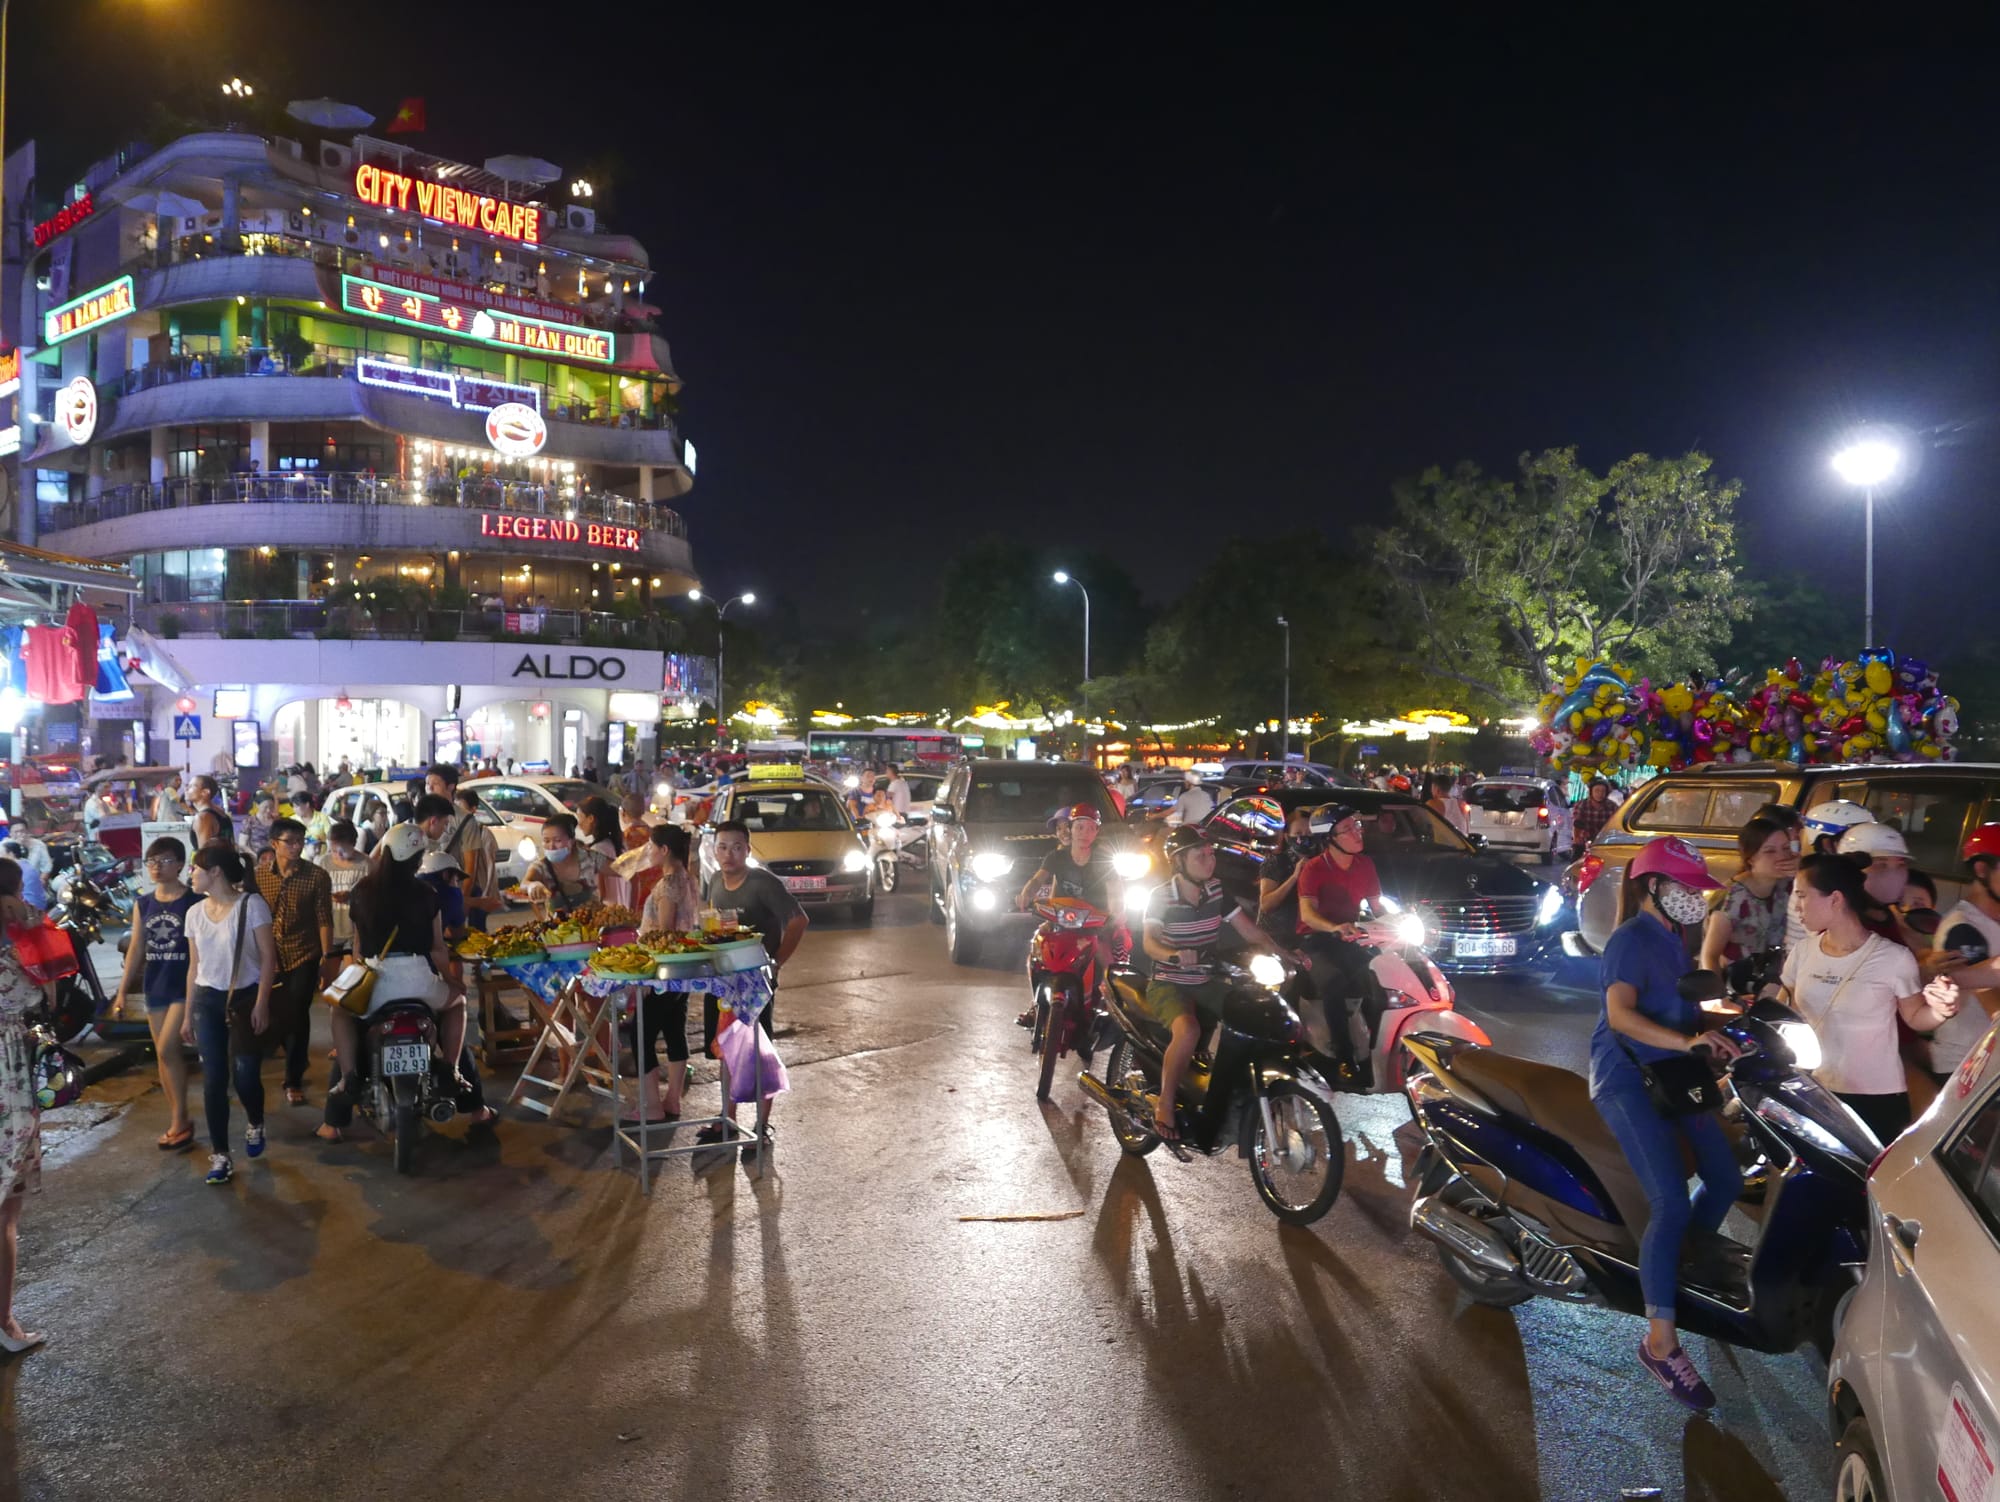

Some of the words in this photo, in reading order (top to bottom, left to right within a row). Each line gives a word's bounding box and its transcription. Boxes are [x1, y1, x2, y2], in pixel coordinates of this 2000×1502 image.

[355, 163, 412, 210] CITY
[416, 180, 480, 228] VIEW
[480, 197, 539, 243] CAFE
[500, 319, 521, 344] MÌ
[525, 325, 560, 350] HÀN
[565, 332, 607, 358] QUỐC
[481, 513, 581, 542] LEGEND
[587, 523, 640, 551] BEER
[511, 653, 627, 681] ALDO
[385, 1058, 427, 1074] 082.93
[389, 1045, 423, 1061] 29-B1
